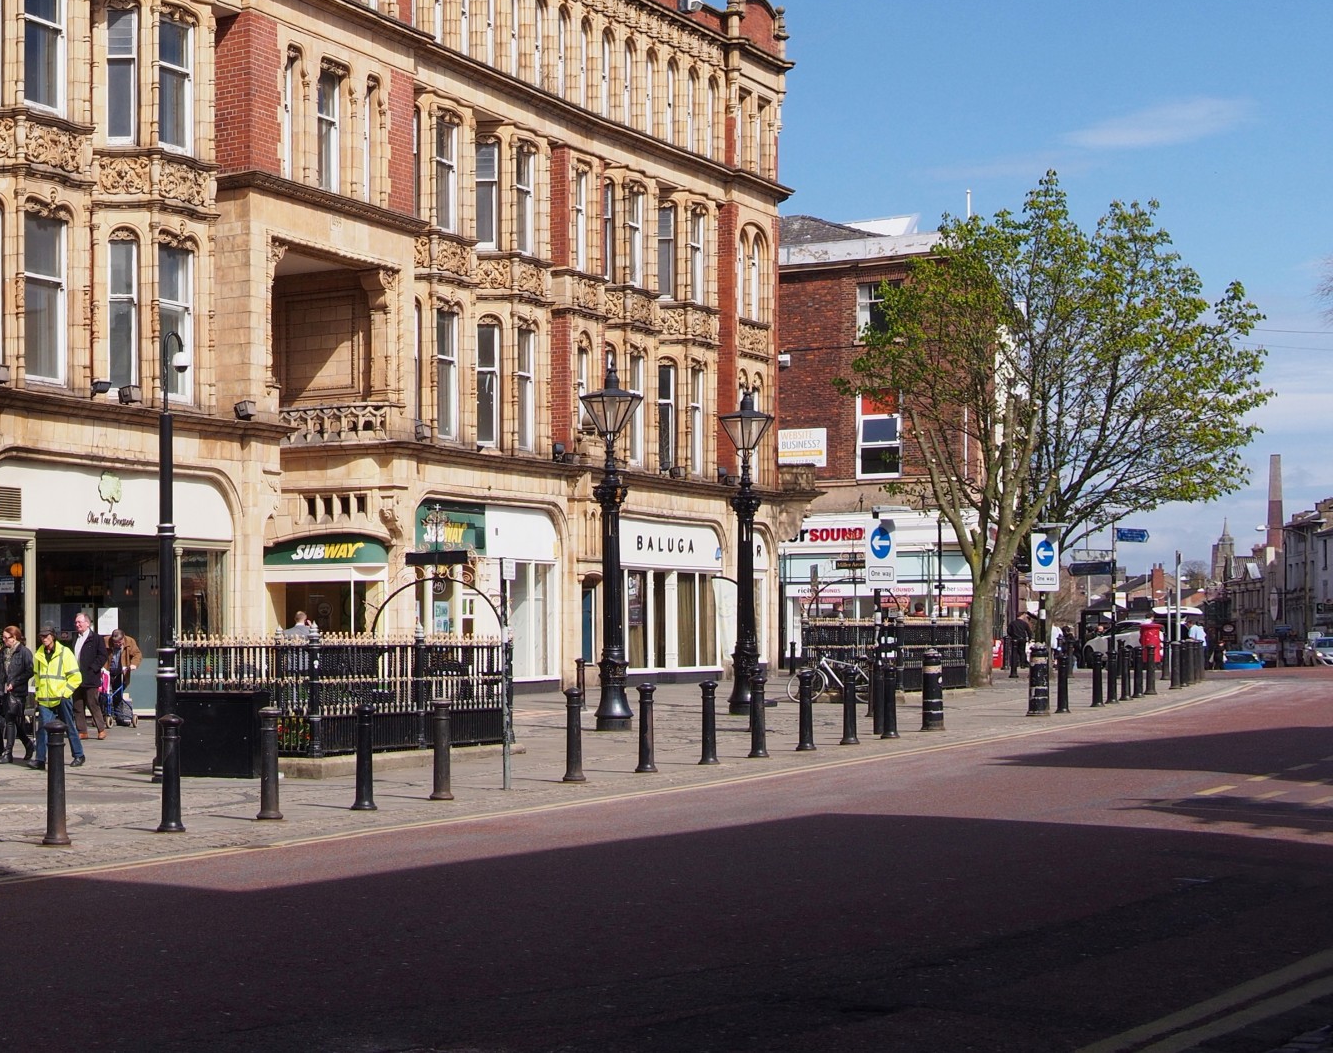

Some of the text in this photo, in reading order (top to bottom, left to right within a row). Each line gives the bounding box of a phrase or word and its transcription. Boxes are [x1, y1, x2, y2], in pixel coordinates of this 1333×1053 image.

[780, 431, 813, 440] WEBSITE
[781, 440, 821, 449] BUSINESS?
[423, 522, 467, 544] SUBWAY
[291, 542, 365, 560] SUBWAY
[636, 535, 694, 554] BALUGA
